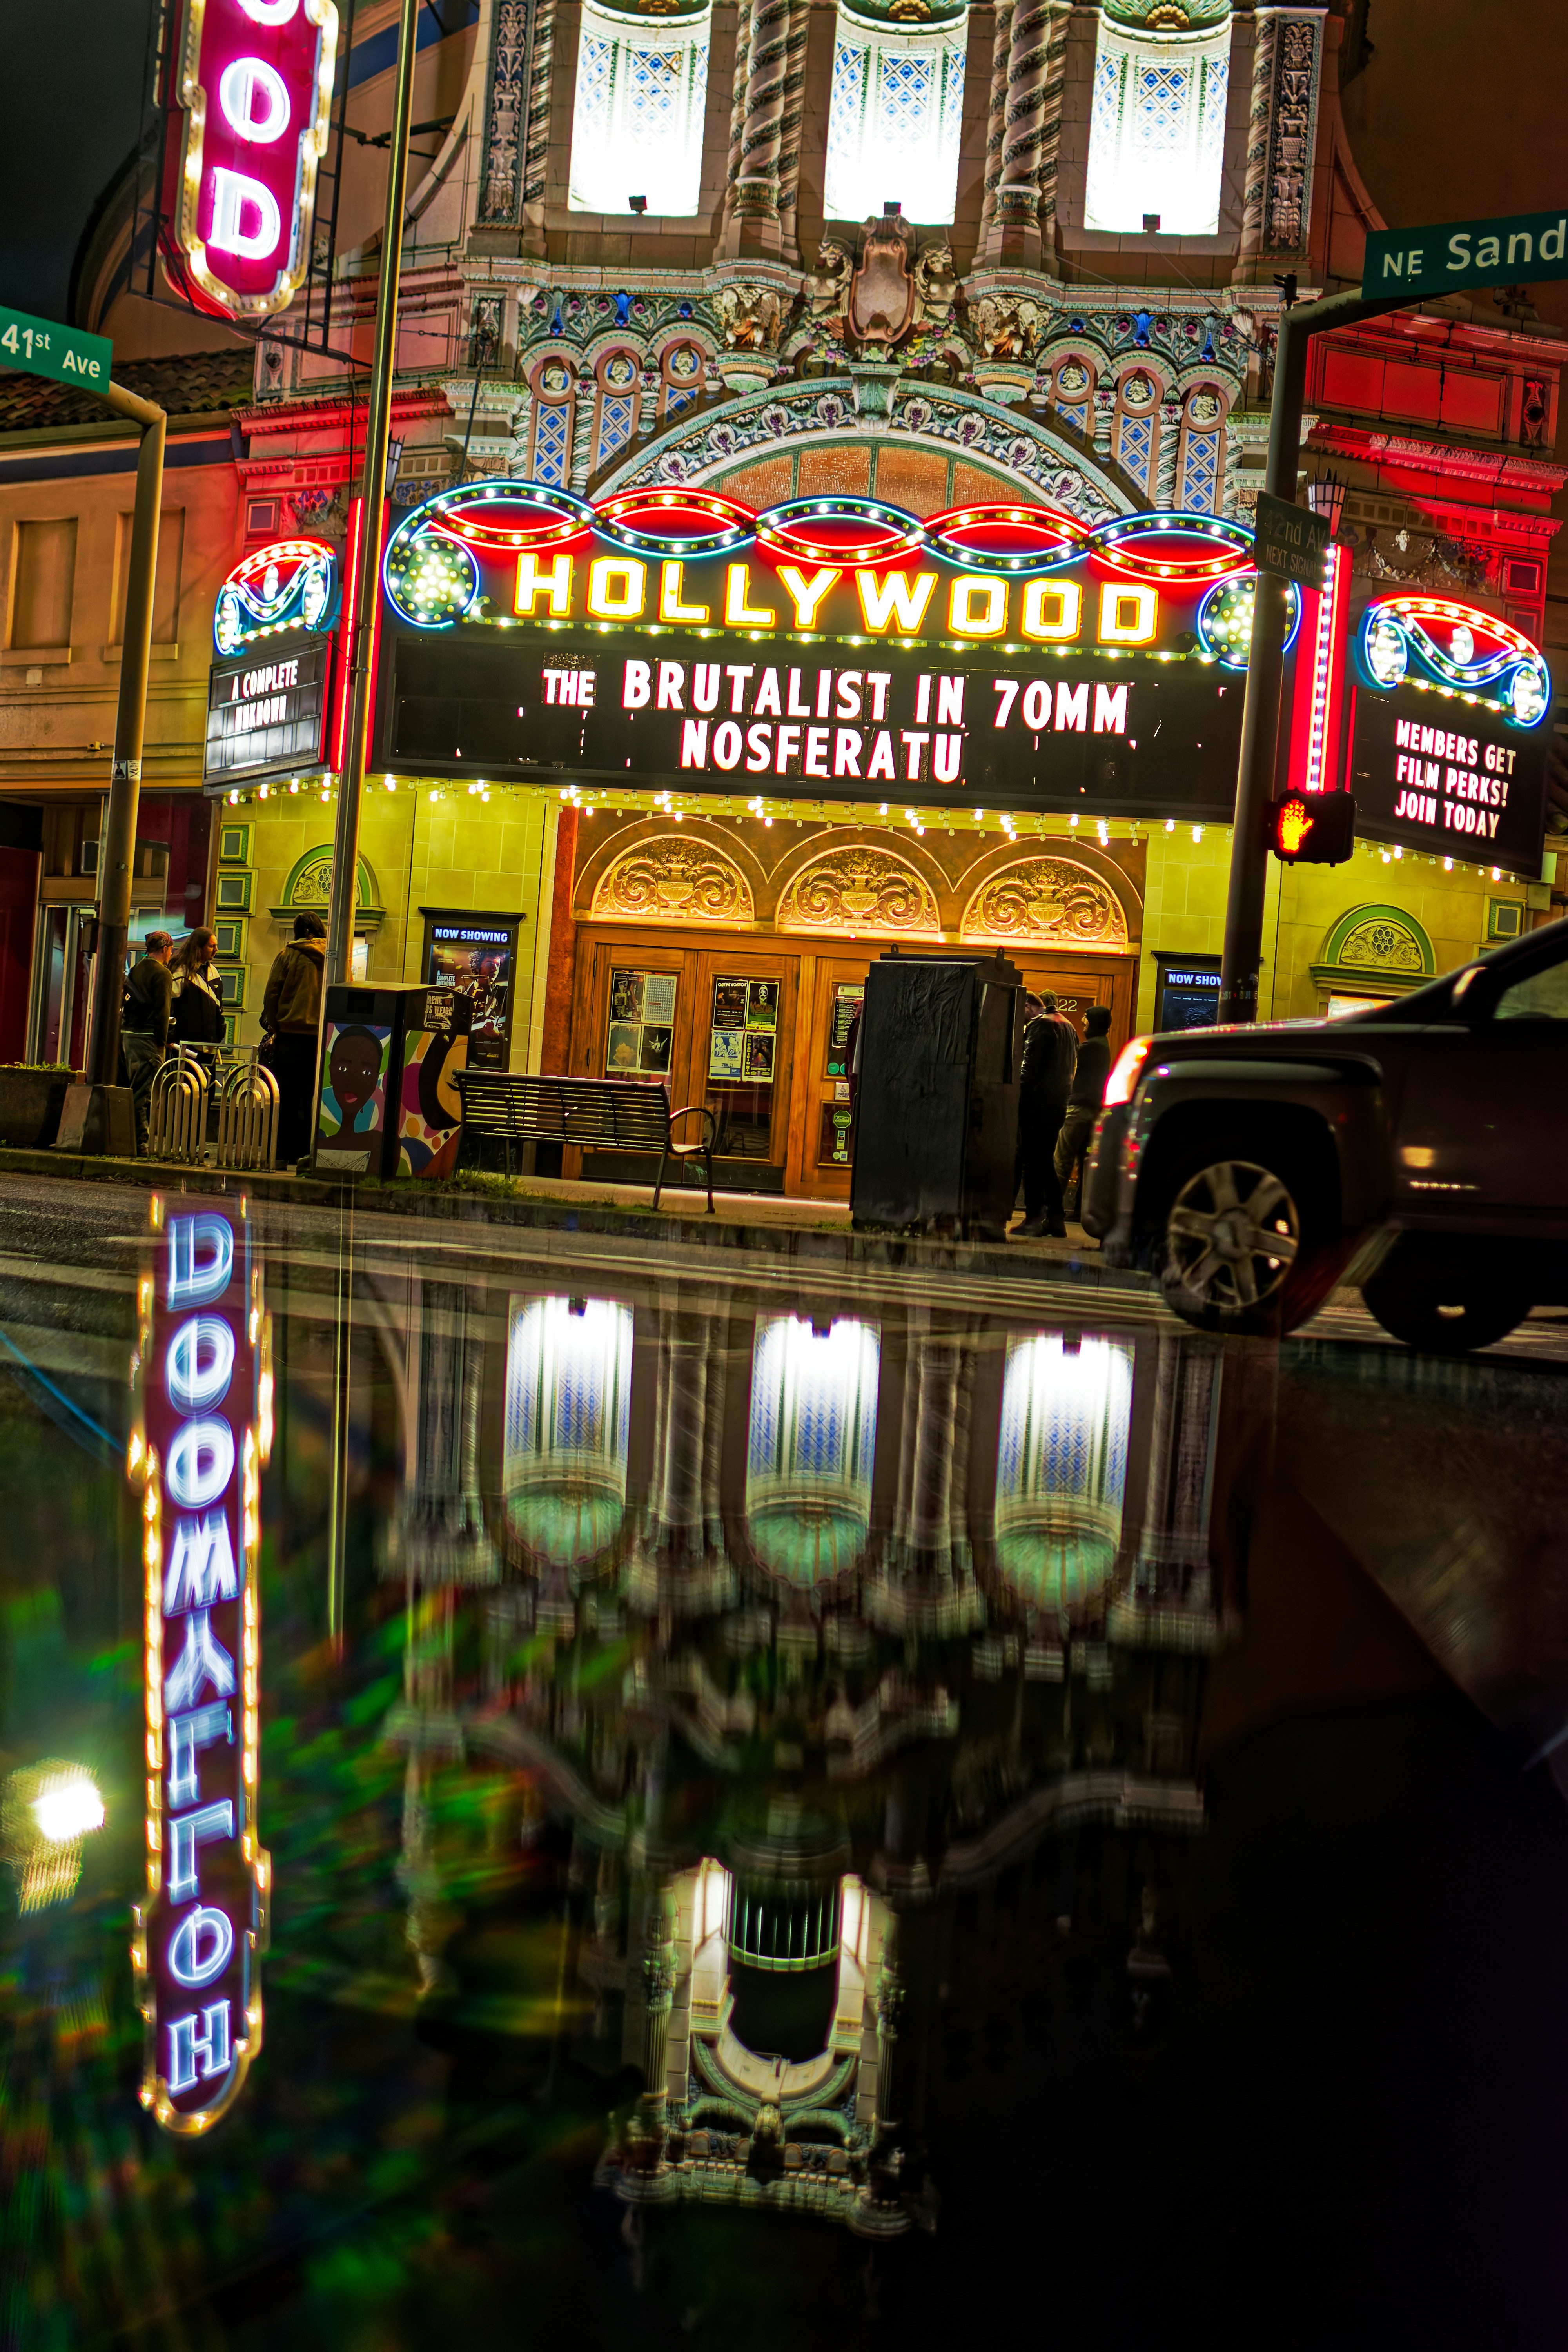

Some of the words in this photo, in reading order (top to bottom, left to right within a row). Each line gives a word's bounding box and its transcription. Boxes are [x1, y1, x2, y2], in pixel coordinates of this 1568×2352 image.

[1383, 250, 1423, 278] NE
[1, 323, 51, 359] 41st
[62, 349, 100, 378] Ave
[1266, 544, 1287, 568] NEXT
[514, 552, 1159, 645] HOLLYWOOD
[230, 676, 239, 701] A
[241, 659, 298, 699] COMPLETE
[542, 669, 596, 706] THE
[622, 659, 892, 721] BRUTALIST
[915, 673, 965, 726] IN
[993, 679, 1131, 735] 70MM
[234, 695, 287, 732] UNKNOWN
[679, 719, 964, 783] NOSFERATU
[1396, 719, 1479, 767] MEMBERS
[1485, 744, 1517, 776] GET
[1396, 753, 1440, 793] FILM
[1446, 767, 1509, 807] PERKS!
[1394, 789, 1436, 825] JOIN
[1444, 800, 1500, 838] TODAY
[435, 928, 459, 939] NOW
[461, 930, 508, 942] SHOWING
[1169, 974, 1194, 984] NOW
